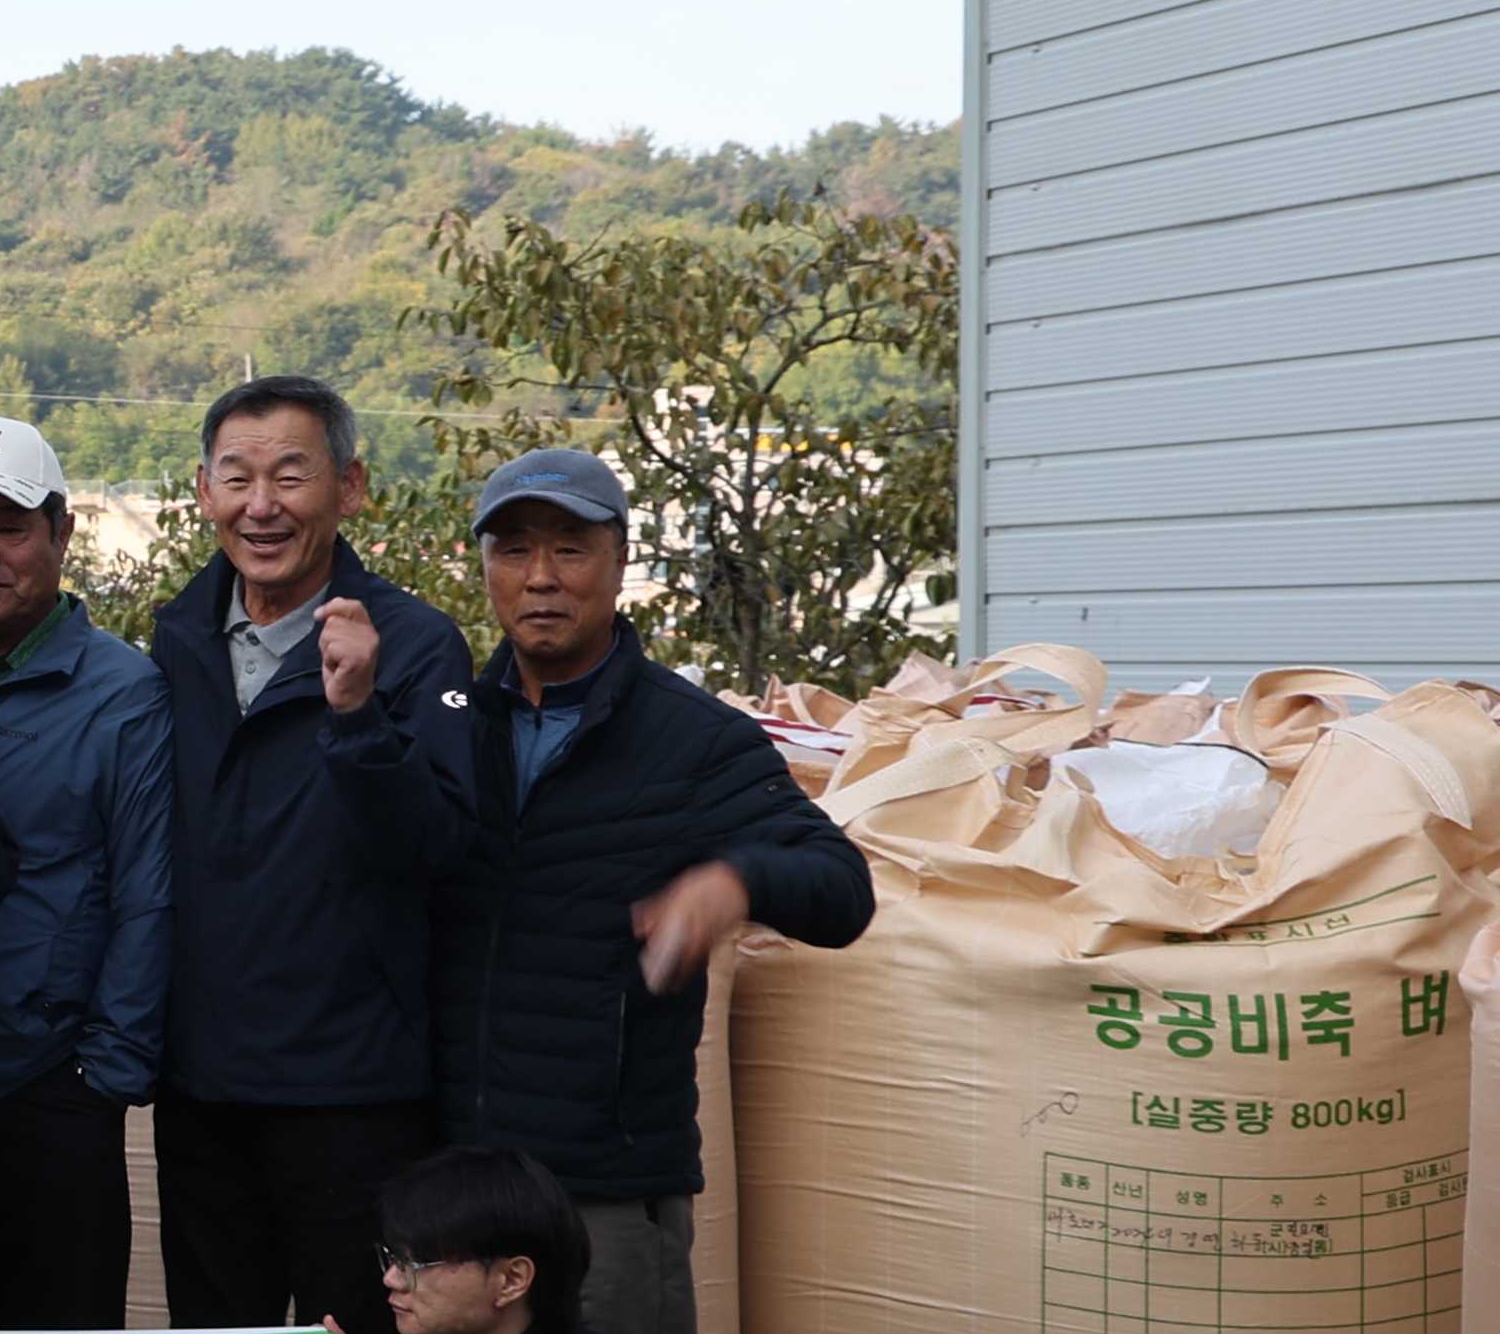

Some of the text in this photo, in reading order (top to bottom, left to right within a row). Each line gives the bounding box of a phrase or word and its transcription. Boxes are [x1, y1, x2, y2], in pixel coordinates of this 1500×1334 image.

[1087, 970, 1449, 1060] 공공비축 벼
[1131, 1091, 1273, 1135] [실중량
[1291, 1088, 1406, 1130] 800kg]
[1061, 1172, 1090, 1190] 품종
[1176, 1190, 1207, 1206] 성명
